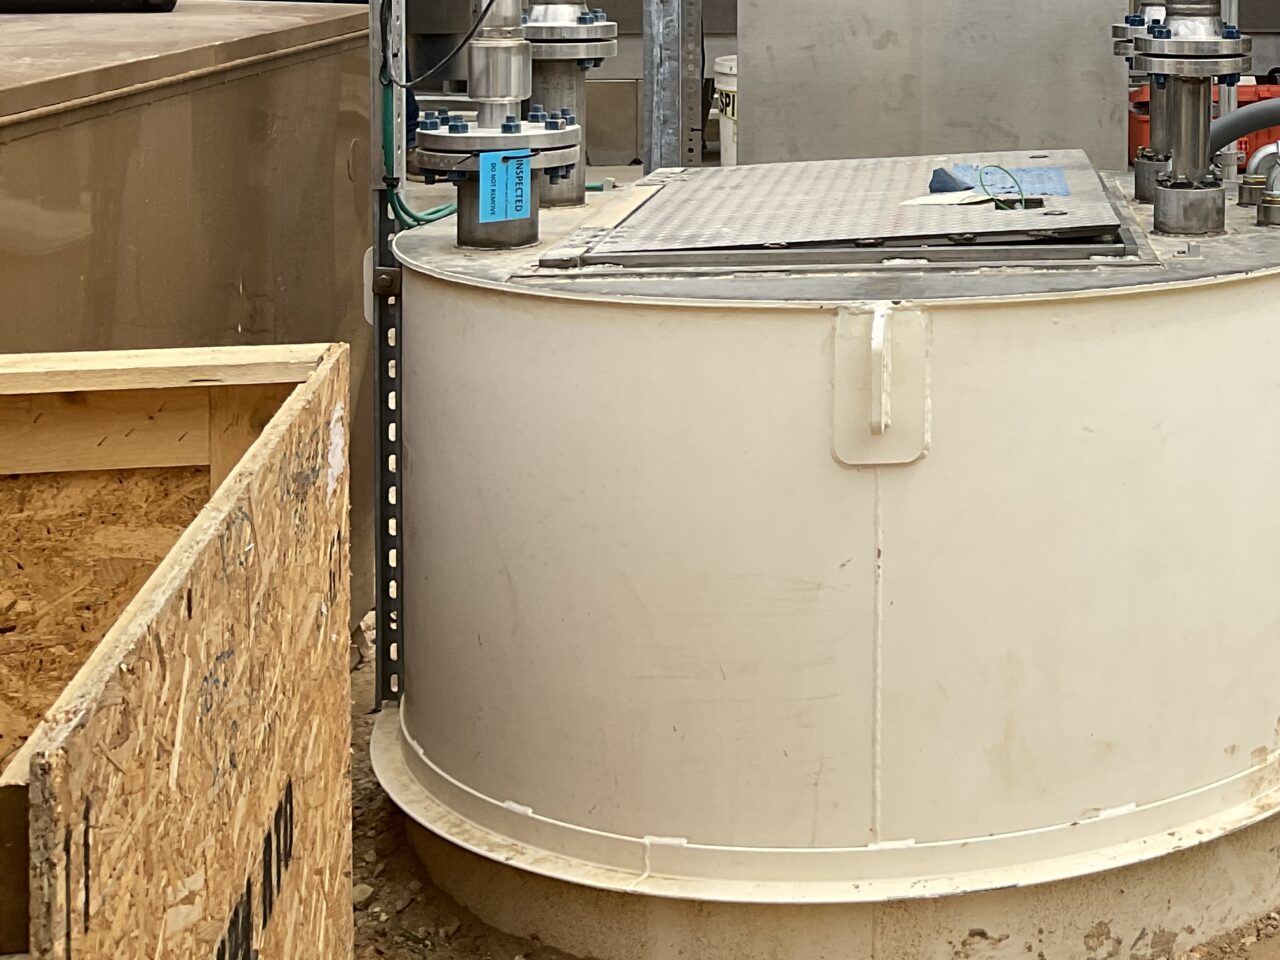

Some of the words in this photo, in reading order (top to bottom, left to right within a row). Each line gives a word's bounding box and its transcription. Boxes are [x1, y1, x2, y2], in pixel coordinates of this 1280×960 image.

[490, 162, 497, 172] DO
[515, 159, 524, 212] INSPECTED
[489, 188, 497, 216] REMOVE
